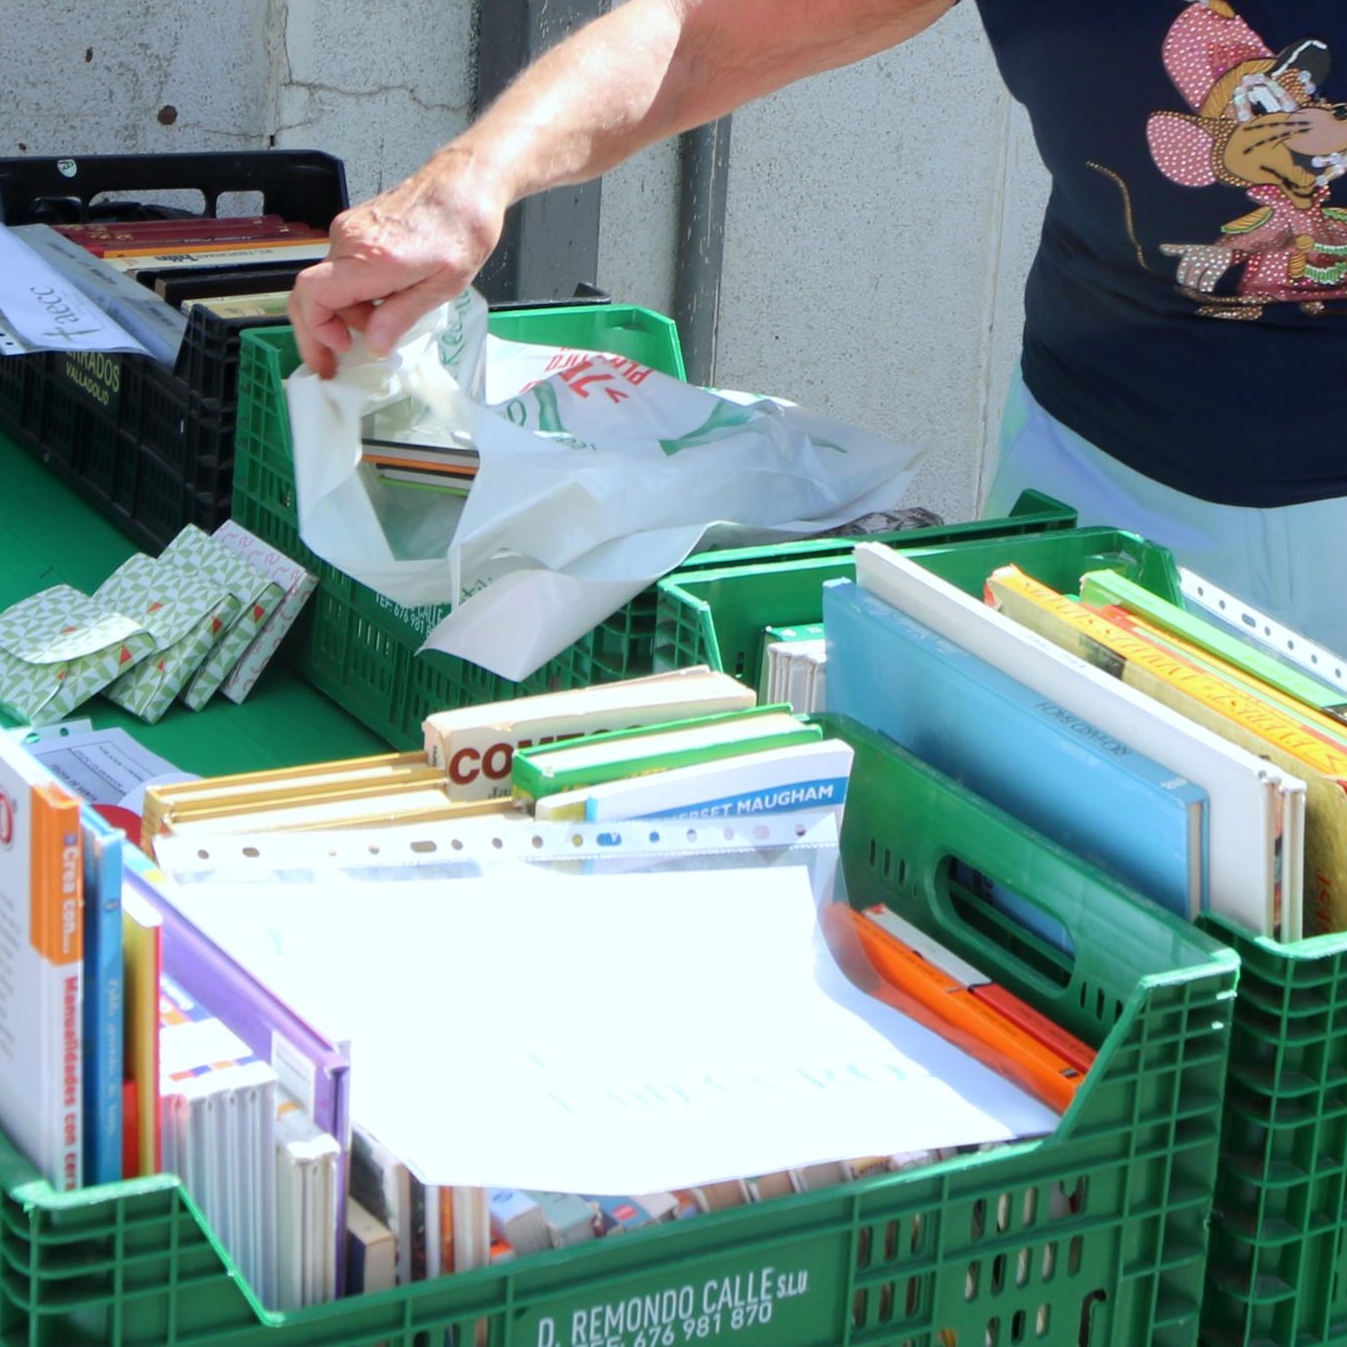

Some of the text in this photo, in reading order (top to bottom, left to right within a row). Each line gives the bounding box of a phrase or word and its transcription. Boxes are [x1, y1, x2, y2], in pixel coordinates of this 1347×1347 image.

[736, 784, 835, 816] MAUGHAM
[62, 847, 78, 893] Crea
[63, 976, 79, 1107] Manualidades
[63, 1112, 77, 1146] con
[571, 1285, 694, 1346] REMONDO
[702, 1268, 774, 1315] CALLE
[633, 1301, 773, 1347] 676 981 870
